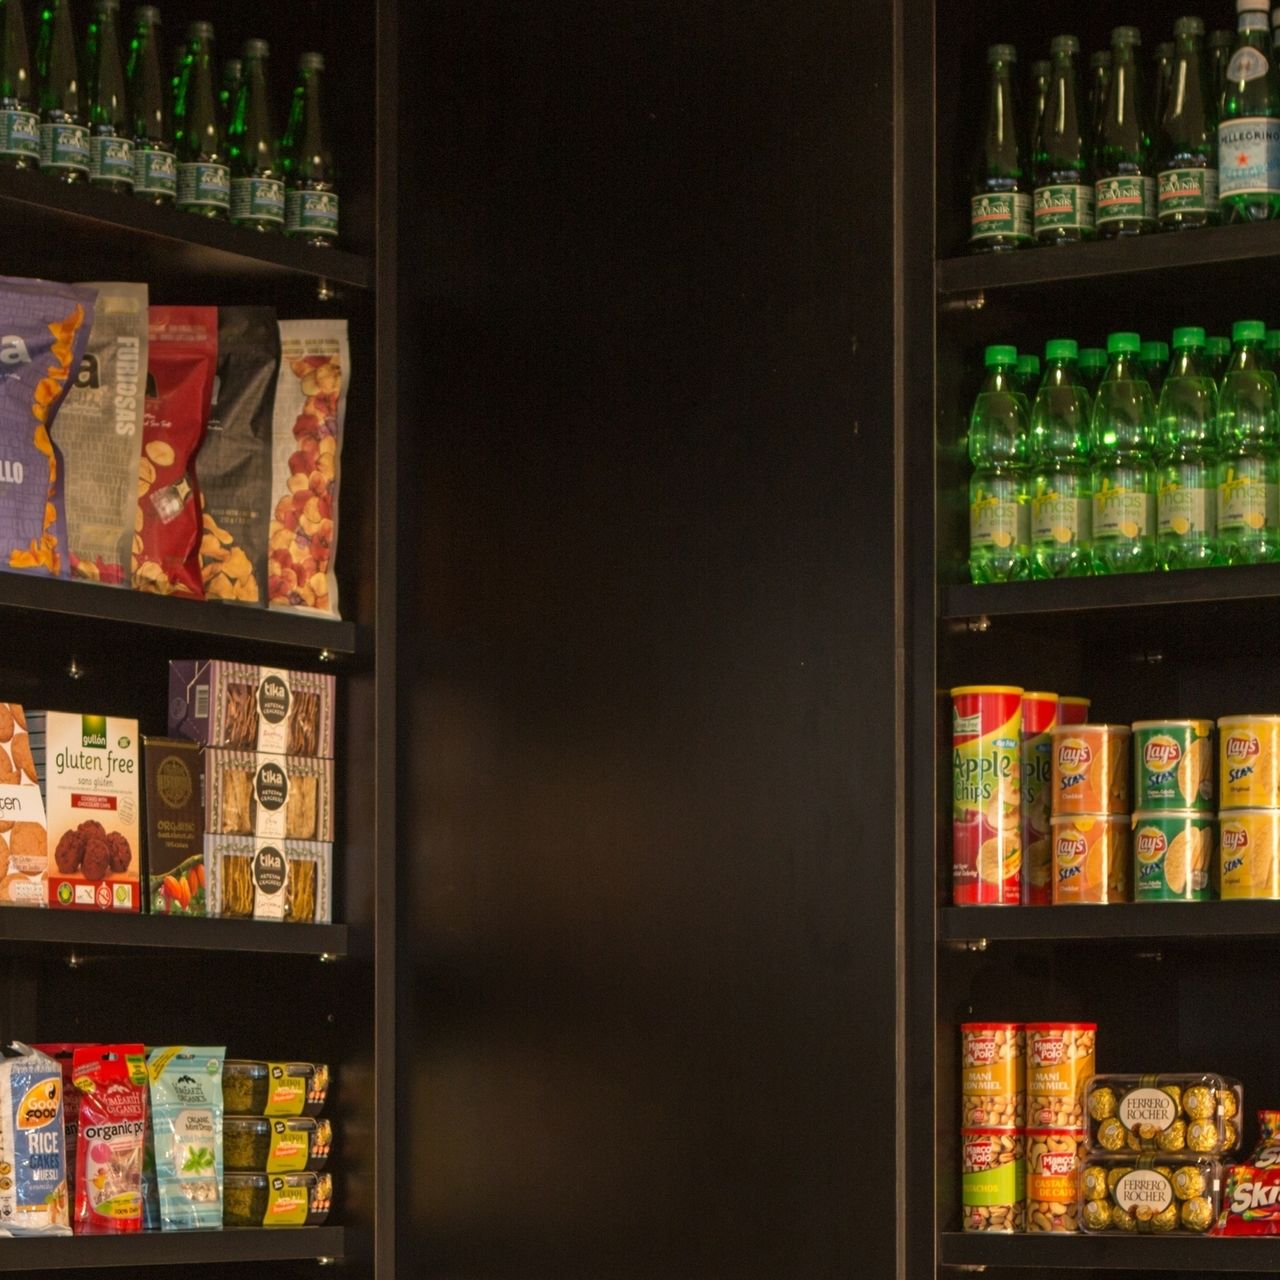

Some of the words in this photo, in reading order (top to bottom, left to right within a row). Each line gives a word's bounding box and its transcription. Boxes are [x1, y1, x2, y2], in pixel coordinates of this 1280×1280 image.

[114, 336, 139, 437] FURIOSAS
[264, 681, 285, 697] tika
[1146, 743, 1179, 764] Lay's
[1227, 737, 1258, 755] Lay's
[55, 747, 103, 775] gluten
[106, 750, 134, 778] free
[954, 748, 1011, 782] Apple
[261, 769, 283, 784] tika
[955, 781, 992, 803] Chips
[260, 853, 281, 868] tika
[979, 1081, 1002, 1090] MIEL
[1045, 1081, 1070, 1090] MIEL
[1127, 1098, 1170, 1109] FERRERO
[25, 1109, 57, 1121] FOOD
[1127, 1109, 1169, 1120] ROCHER
[86, 1123, 132, 1140] organic
[28, 1132, 59, 1154] RICE
[29, 1154, 60, 1170] CAKES
[1123, 1179, 1167, 1190] FERRERO
[1123, 1191, 1166, 1202] ROCHER
